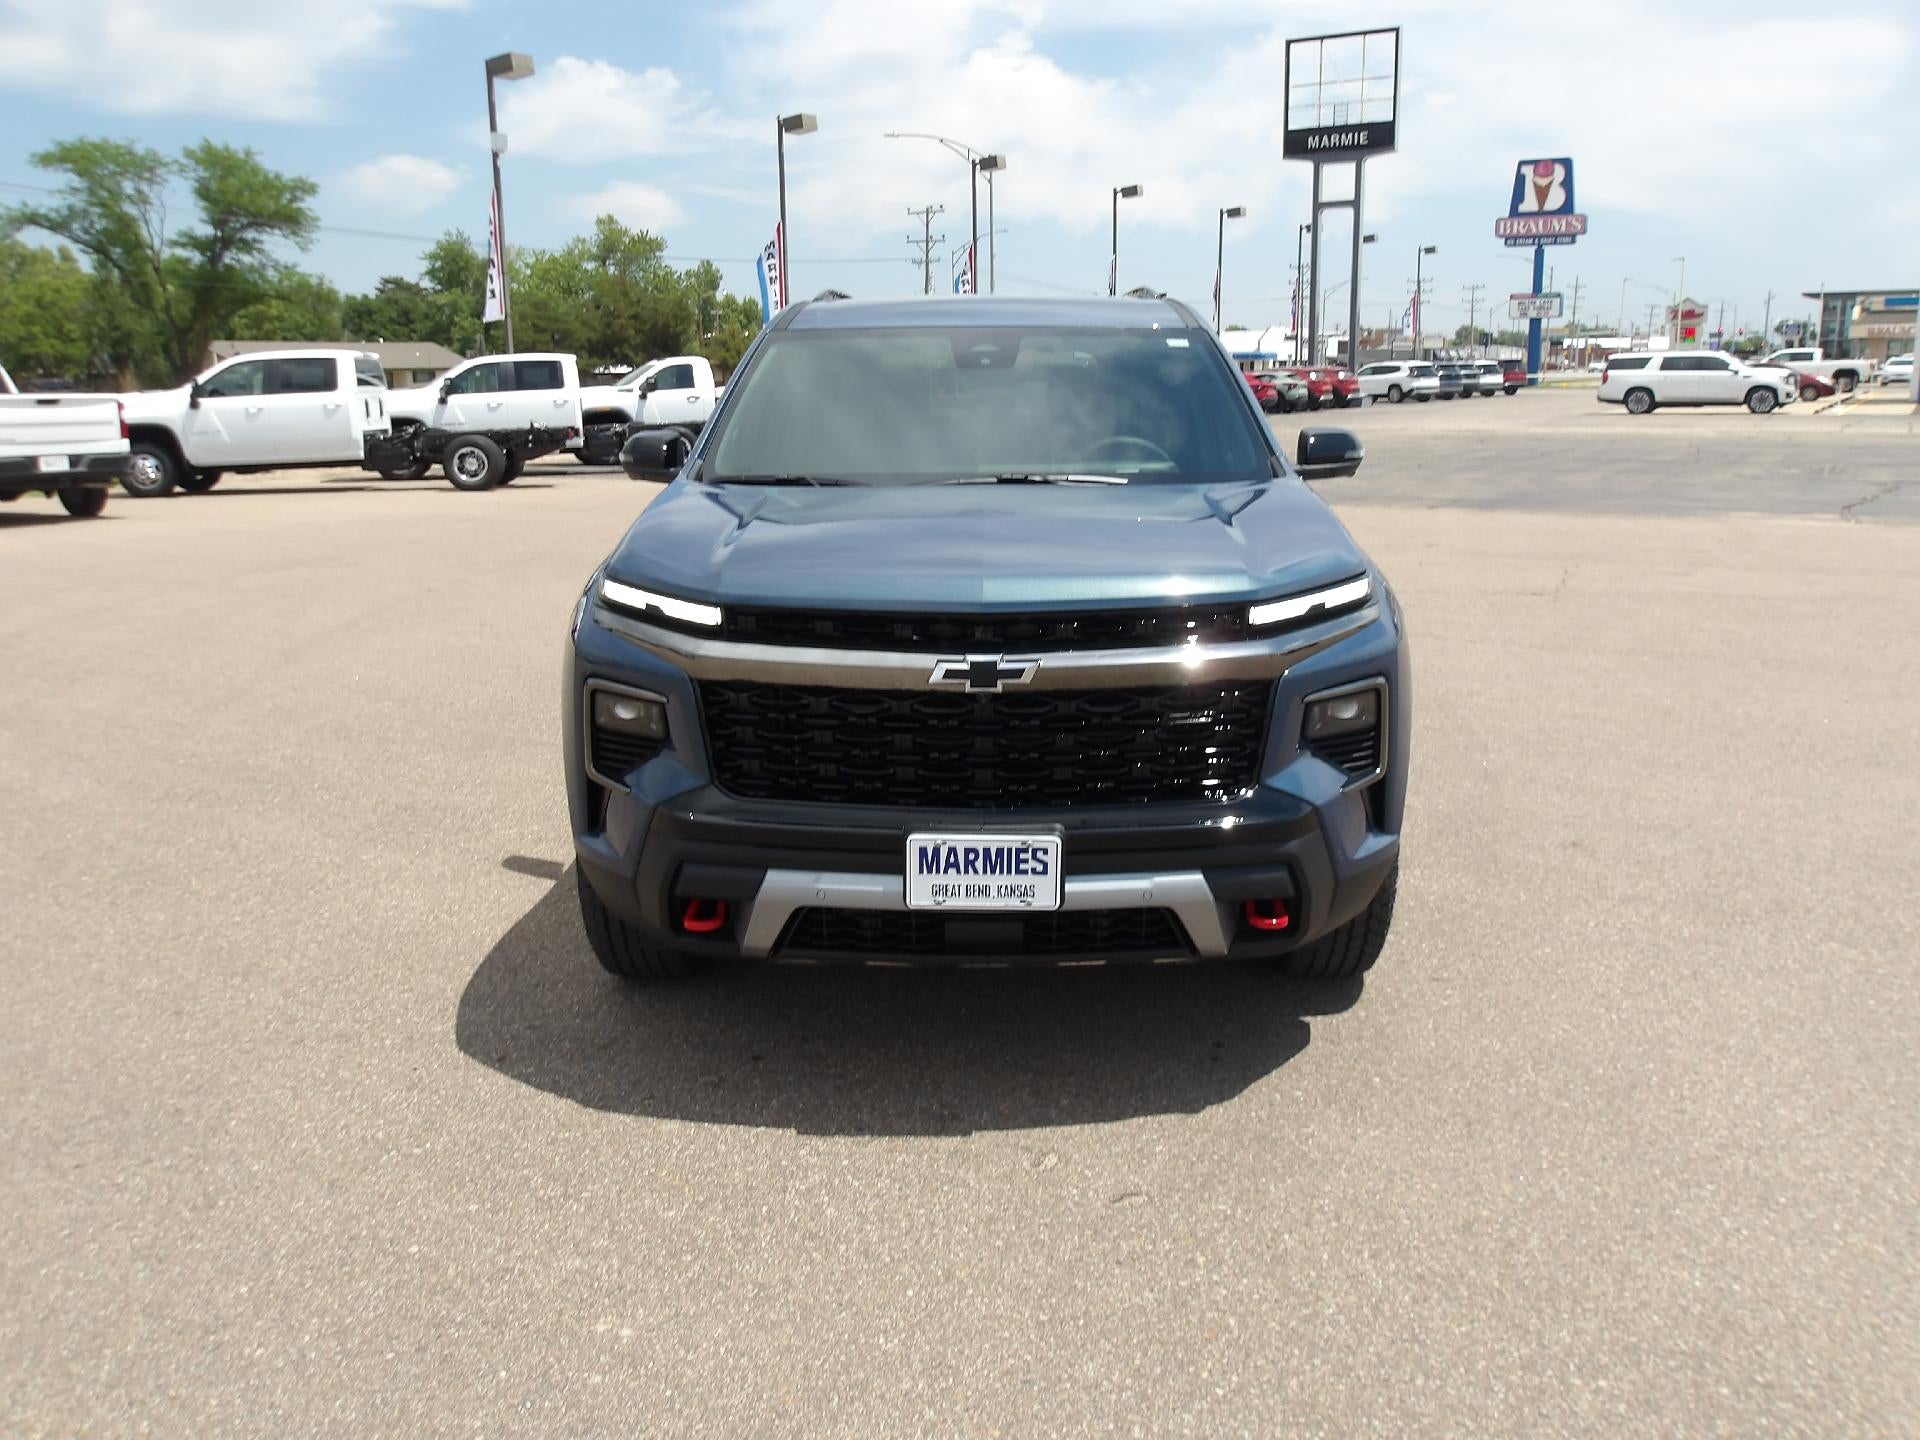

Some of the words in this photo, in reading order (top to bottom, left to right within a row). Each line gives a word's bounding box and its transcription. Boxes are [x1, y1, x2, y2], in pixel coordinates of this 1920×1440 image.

[1308, 131, 1369, 149] MARMIE
[1499, 217, 1582, 235] BRAUM'S
[918, 846, 1049, 875] MARMIES
[932, 883, 961, 898] GREAT
[997, 883, 1035, 898] KANSAS
